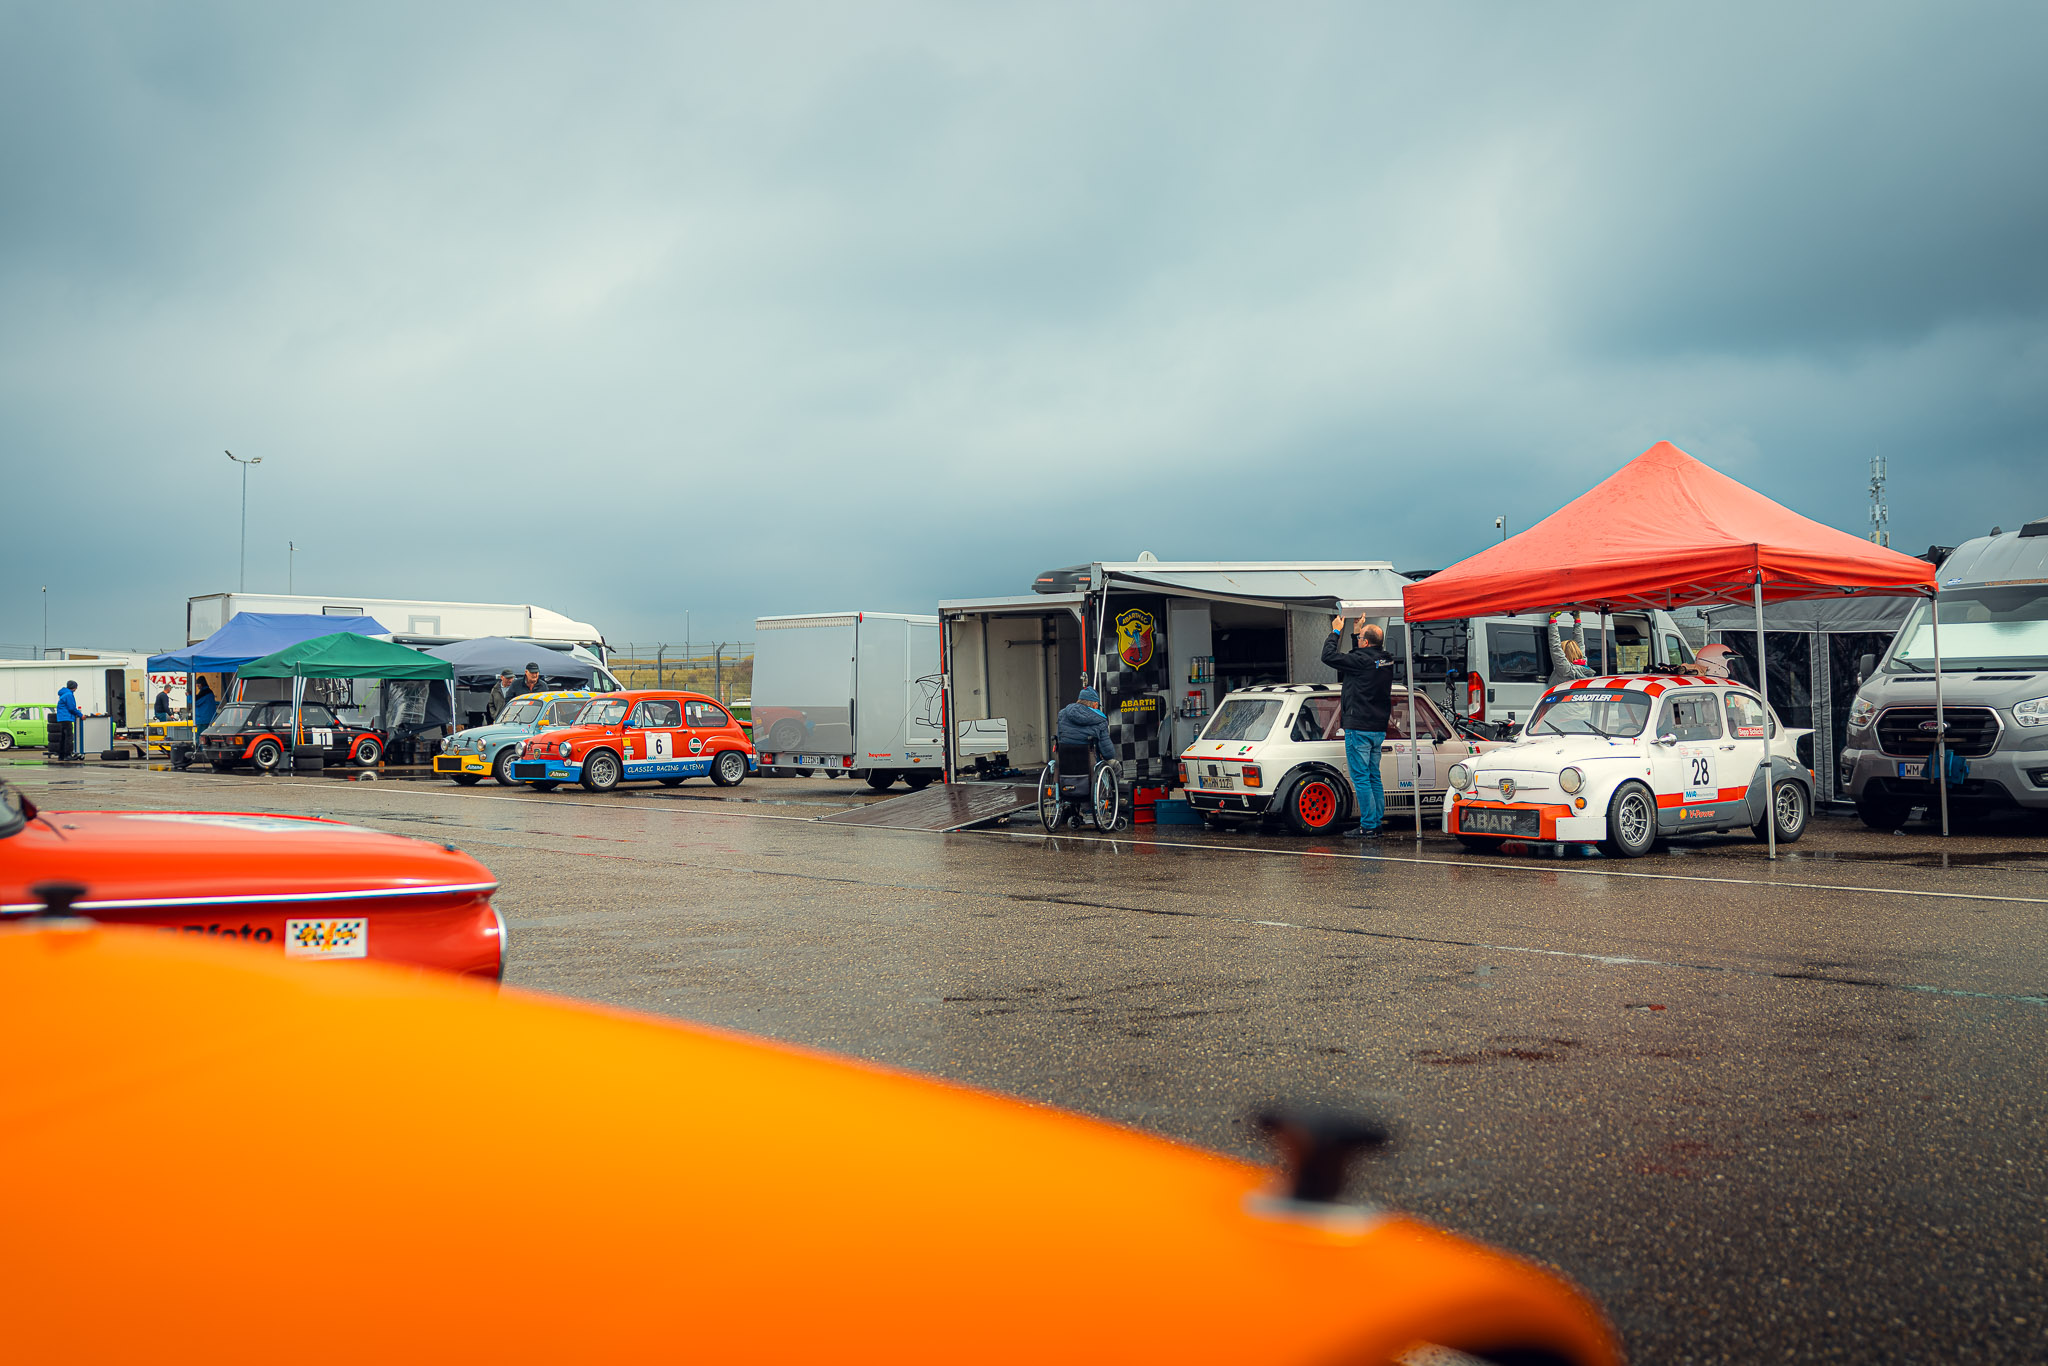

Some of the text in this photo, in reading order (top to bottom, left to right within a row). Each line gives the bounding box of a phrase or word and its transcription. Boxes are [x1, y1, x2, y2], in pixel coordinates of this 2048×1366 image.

[1121, 699, 1156, 707] ABARTH
[1572, 694, 1612, 702] SANDTLER
[319, 733, 328, 747] 11
[656, 739, 663, 755] 6
[628, 763, 705, 773] CLASSIC RACING ALTENA
[1692, 758, 1710, 785] 28
[1906, 764, 1919, 775] WM
[1690, 810, 1715, 818] V-Power
[1464, 813, 1517, 832] ABAR
